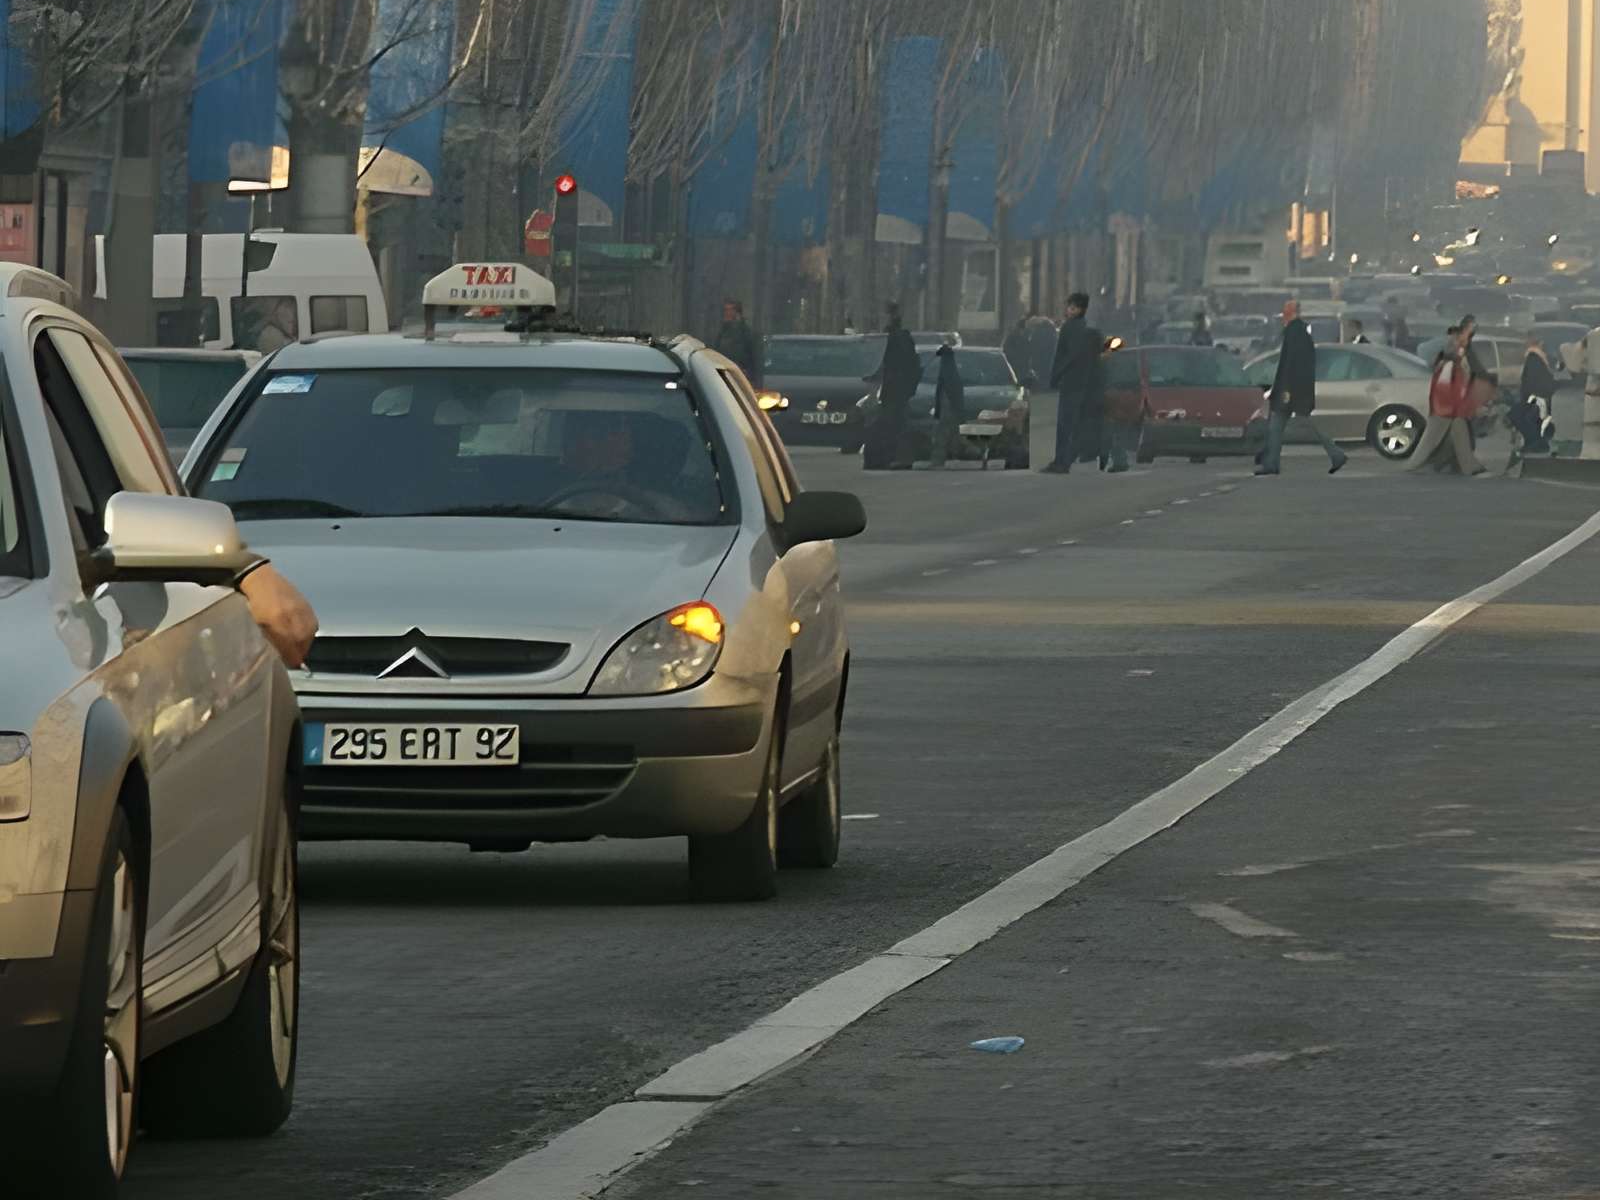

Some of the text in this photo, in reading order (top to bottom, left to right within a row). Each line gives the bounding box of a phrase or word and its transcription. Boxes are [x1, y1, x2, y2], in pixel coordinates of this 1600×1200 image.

[462, 266, 516, 286] TAXI
[330, 728, 387, 760] 295
[476, 727, 517, 760] 92
